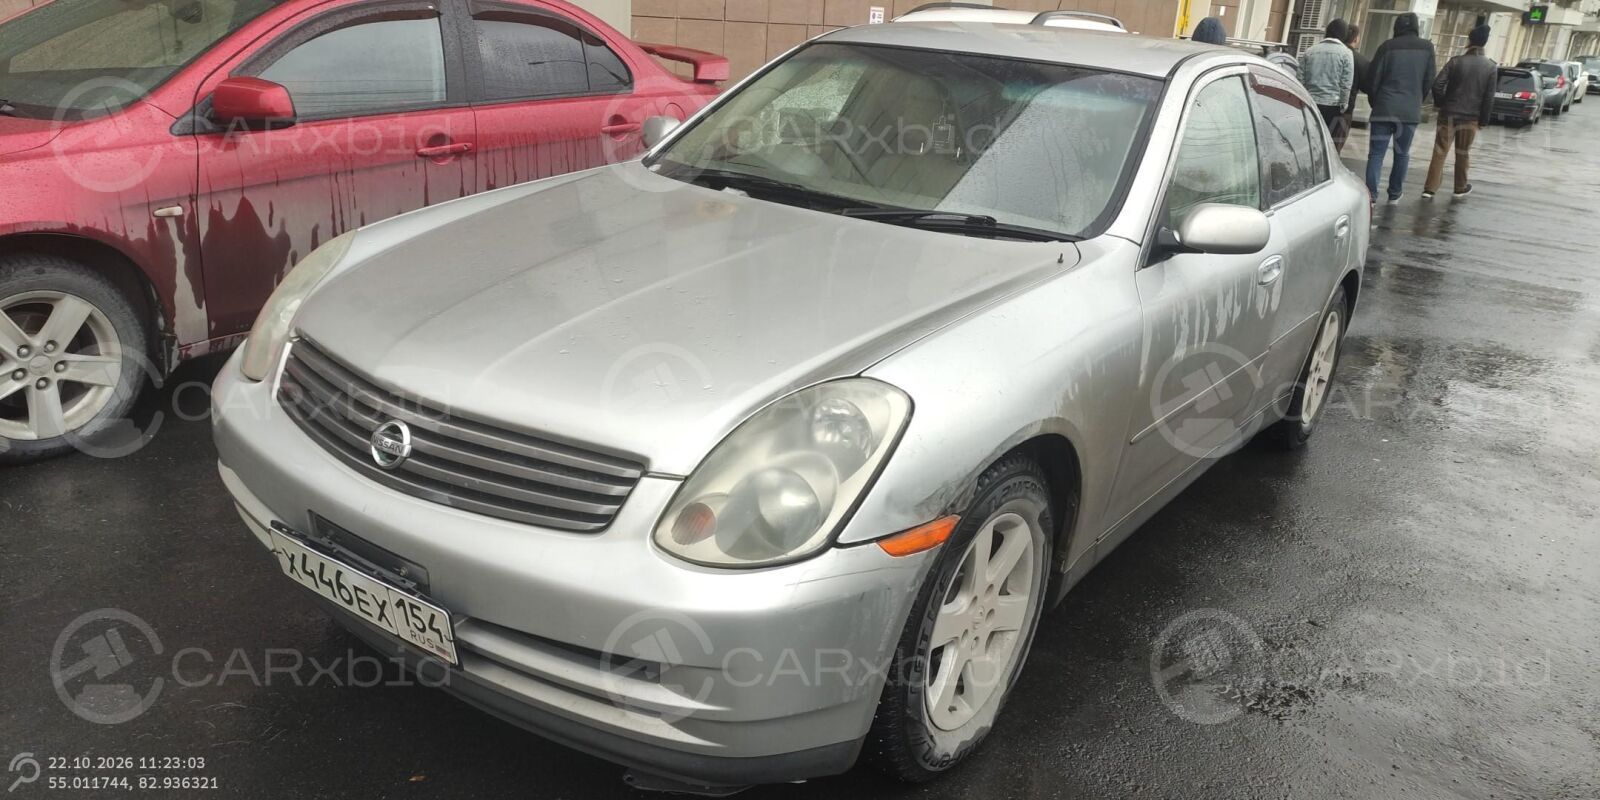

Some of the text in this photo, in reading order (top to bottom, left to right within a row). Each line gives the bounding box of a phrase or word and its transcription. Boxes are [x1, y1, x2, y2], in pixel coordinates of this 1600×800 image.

[373, 433, 403, 454] NISSAN
[394, 598, 444, 644] 154
[410, 629, 435, 649] RUS
